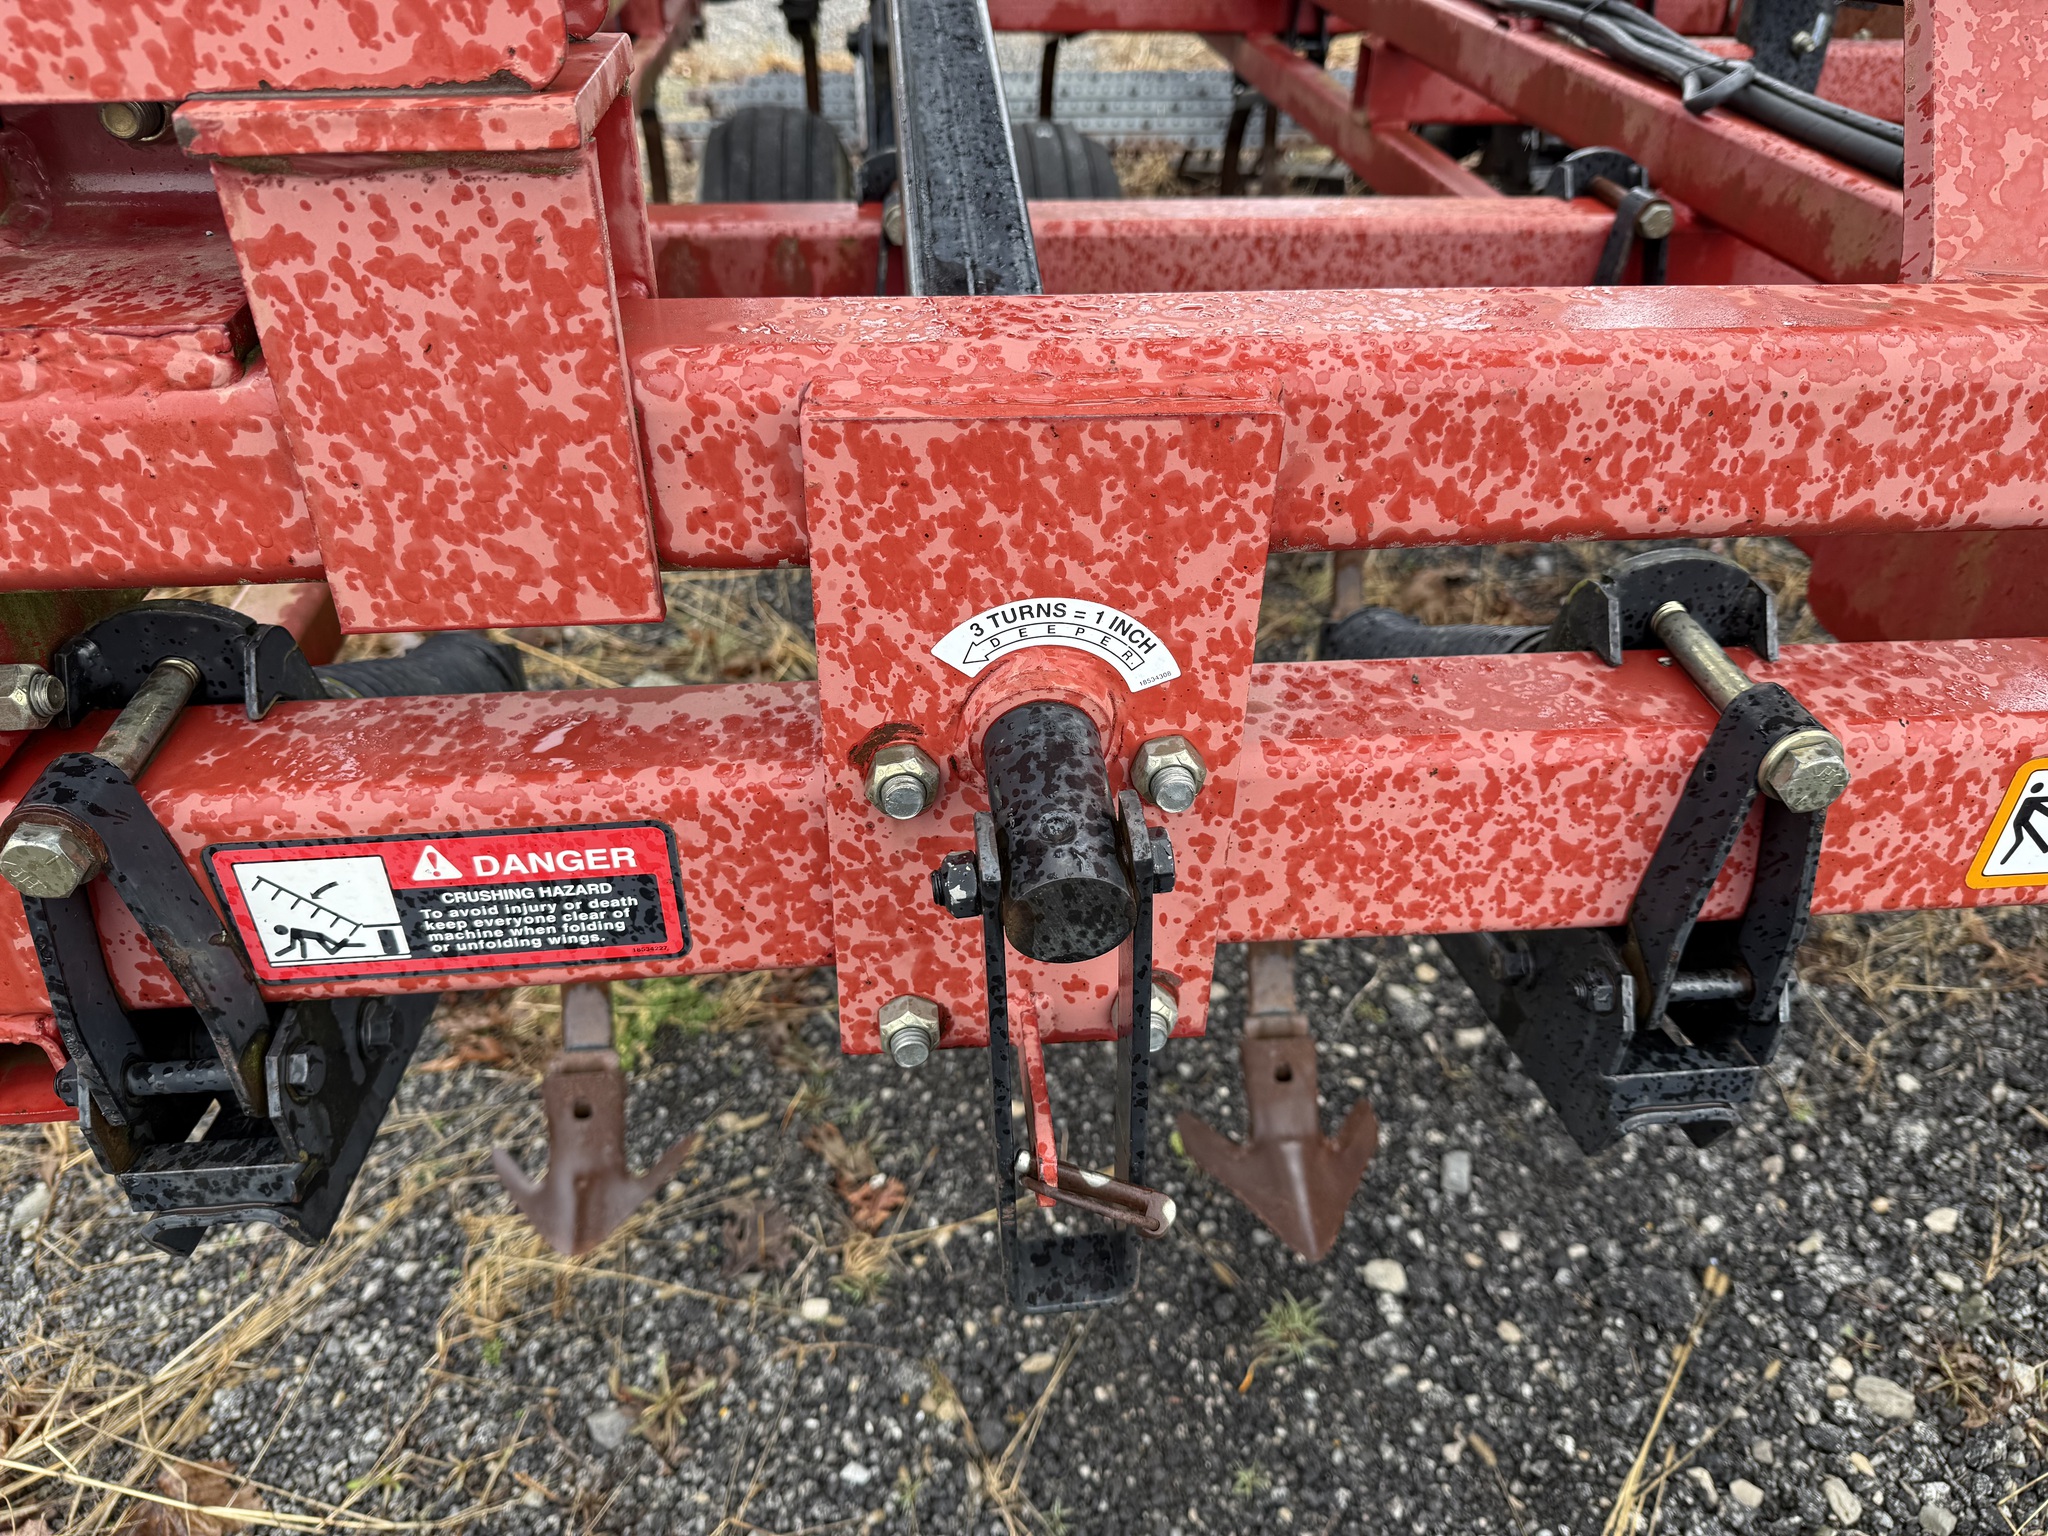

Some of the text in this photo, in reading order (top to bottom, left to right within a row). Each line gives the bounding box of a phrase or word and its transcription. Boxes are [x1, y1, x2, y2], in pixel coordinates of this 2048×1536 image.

[970, 603, 1157, 654] 3 TURNS = 1 INCH
[472, 847, 637, 877] DANGER
[441, 883, 612, 903] CRUSHING HAZARD
[420, 896, 638, 919] To avoid injury or death
[424, 908, 630, 934] keep everyone clear of
[428, 921, 626, 942] machine when folding
[432, 933, 605, 953] or unfolding wings.
